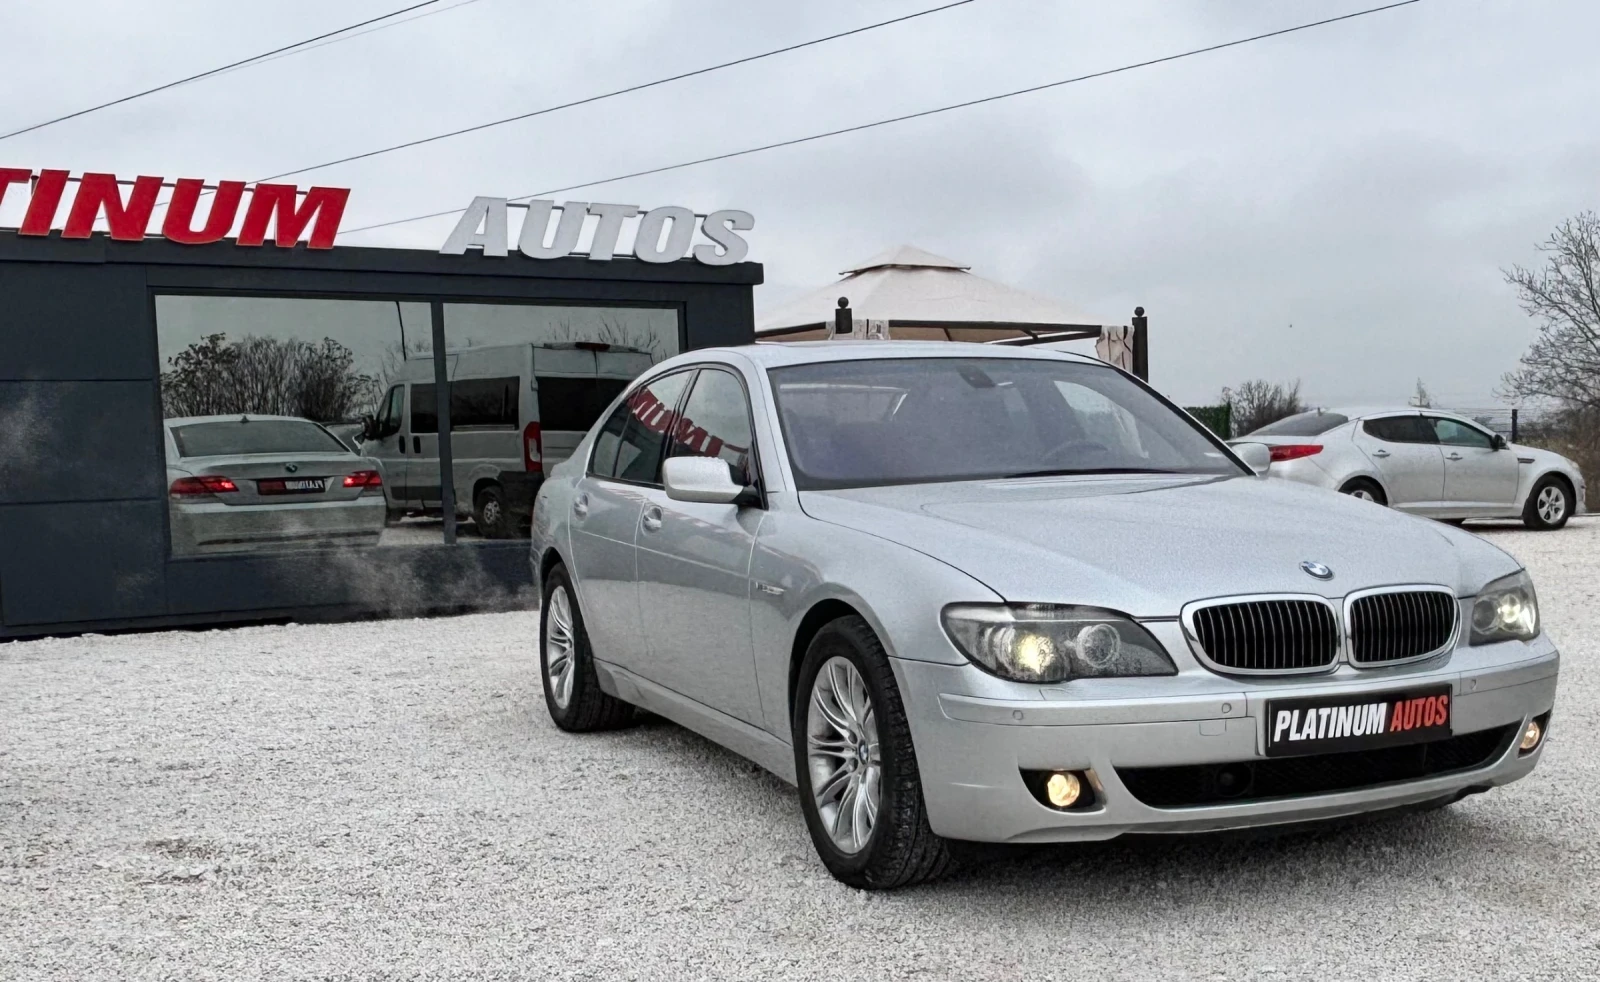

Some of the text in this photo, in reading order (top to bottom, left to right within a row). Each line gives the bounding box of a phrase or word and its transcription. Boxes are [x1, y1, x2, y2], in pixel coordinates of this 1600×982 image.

[439, 196, 755, 266] AUTOS
[1273, 694, 1449, 743] PLATINUM AUTOS
